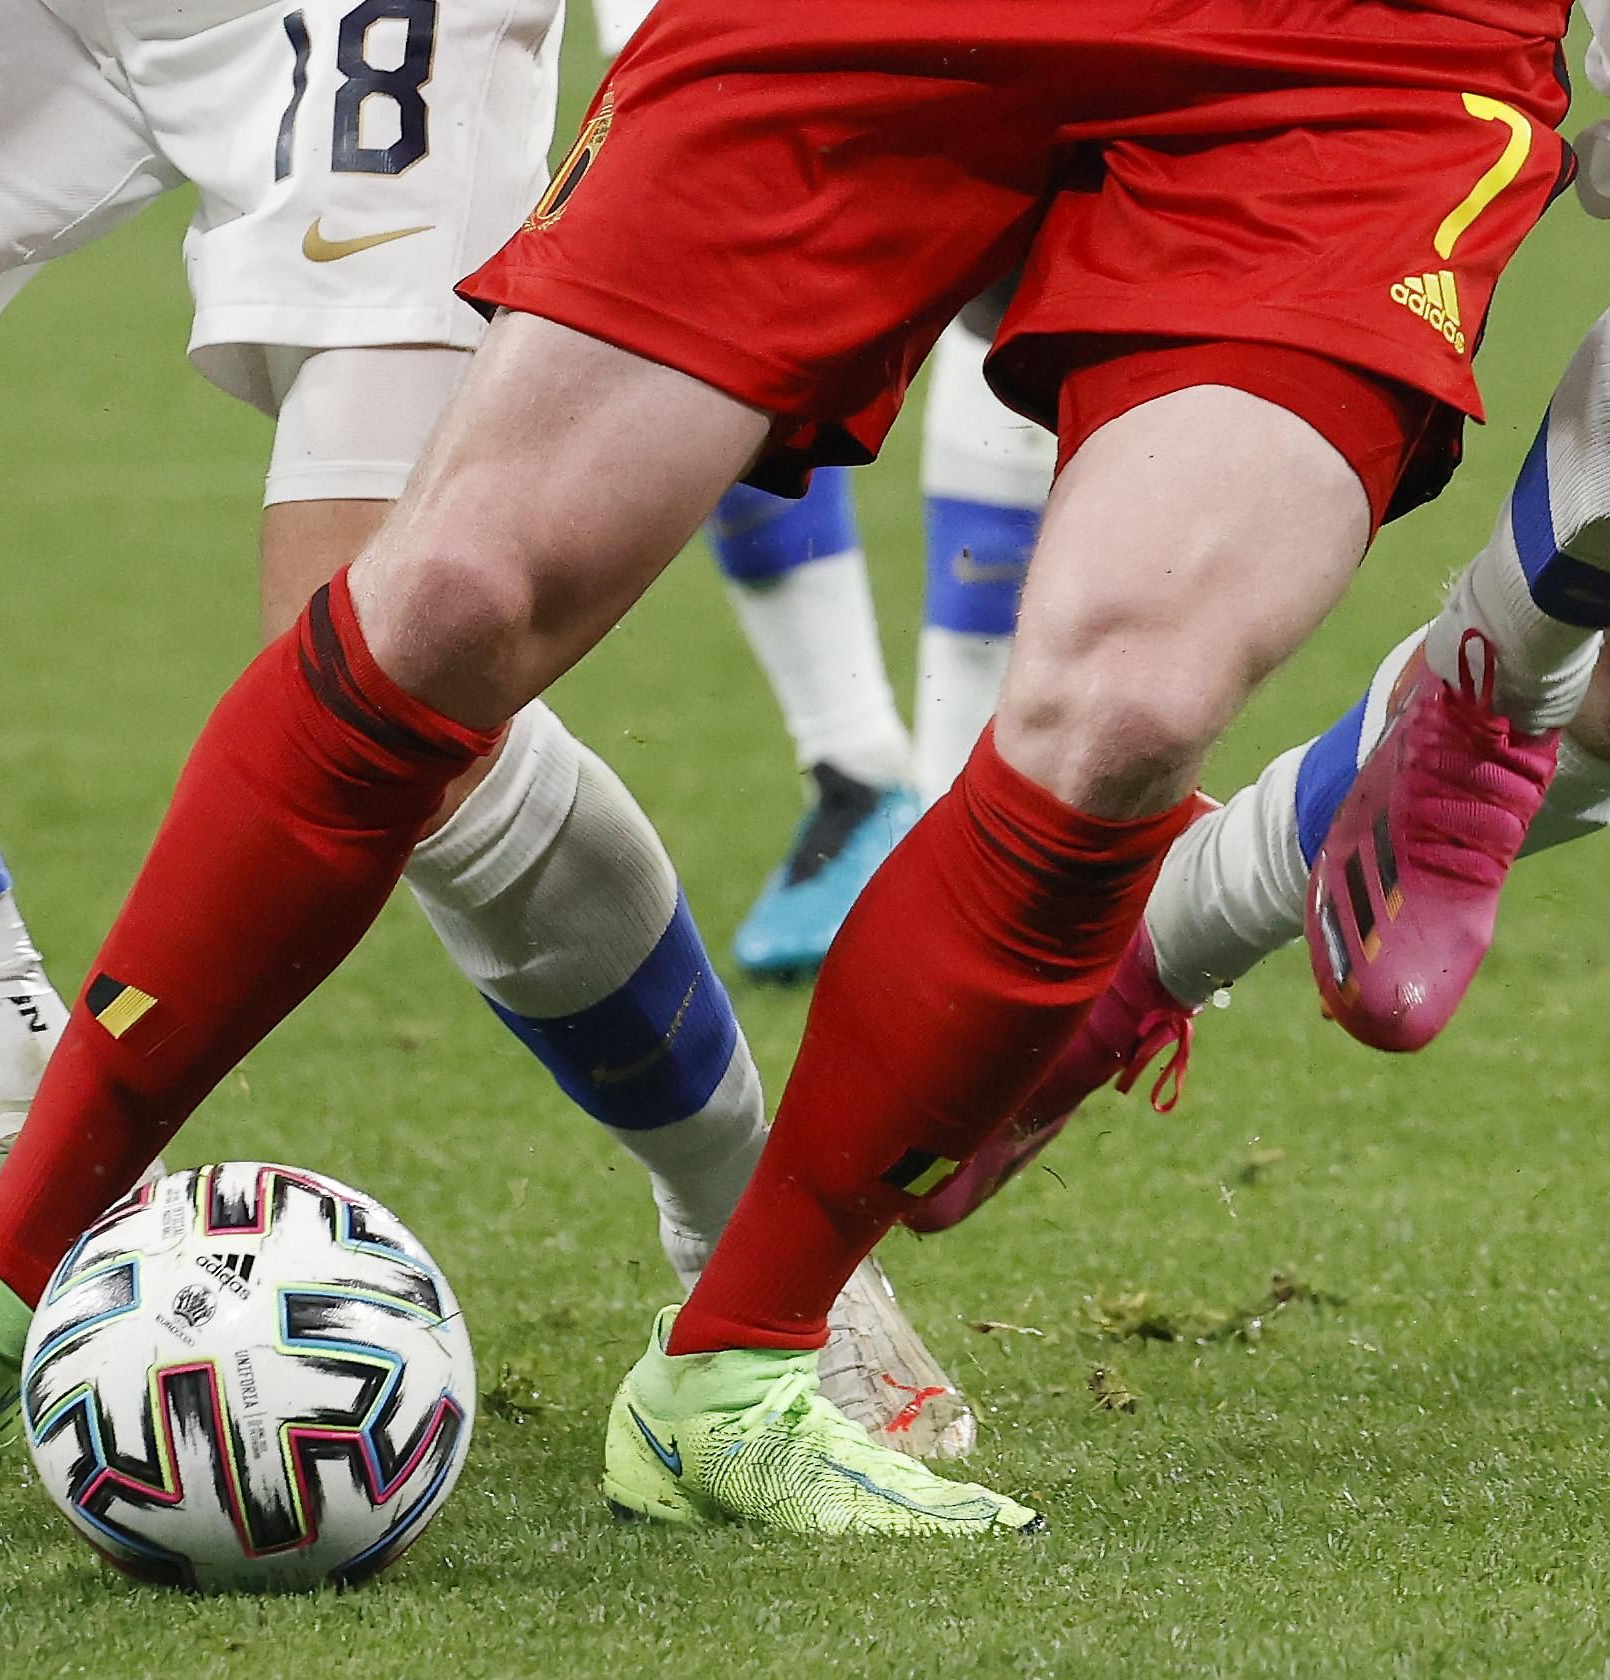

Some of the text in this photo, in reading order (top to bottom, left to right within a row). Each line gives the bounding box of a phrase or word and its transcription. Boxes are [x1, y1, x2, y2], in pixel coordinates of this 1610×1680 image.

[1434, 92, 1532, 261] 7
[1390, 283, 1465, 354] adidas
[196, 1256, 250, 1300] adidas
